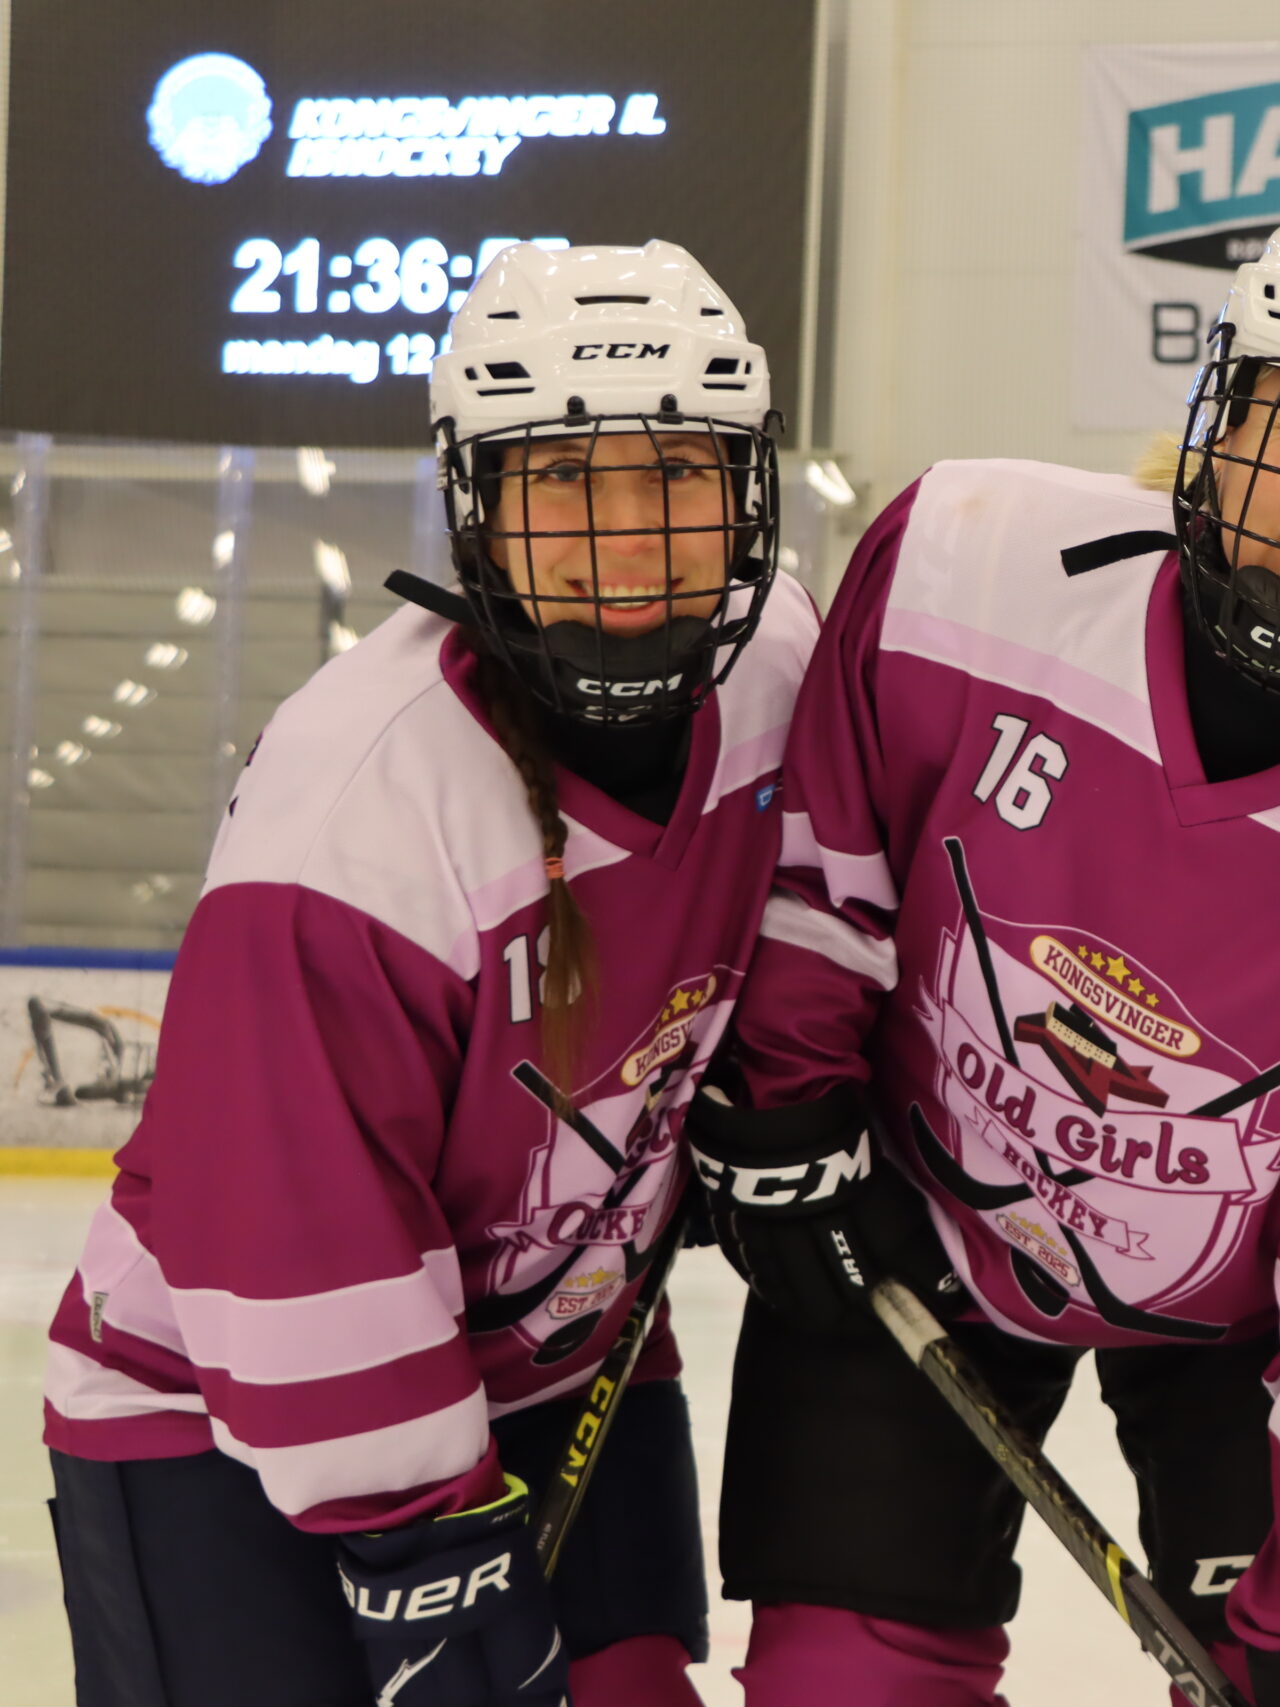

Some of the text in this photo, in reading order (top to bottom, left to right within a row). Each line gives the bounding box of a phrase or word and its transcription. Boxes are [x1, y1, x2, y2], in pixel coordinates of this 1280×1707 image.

[229, 237, 571, 314] 21:36:
[572, 343, 671, 362] CCM
[577, 673, 683, 697] CCM
[972, 712, 1070, 832] 16
[1042, 943, 1185, 1051] KONGSVINGER
[956, 1041, 1212, 1185] Old Girls
[689, 1128, 872, 1206] CCM
[1002, 1141, 1109, 1239] HOCKEY
[1037, 1245, 1075, 1280] 2025
[560, 1374, 618, 1489] CCM
